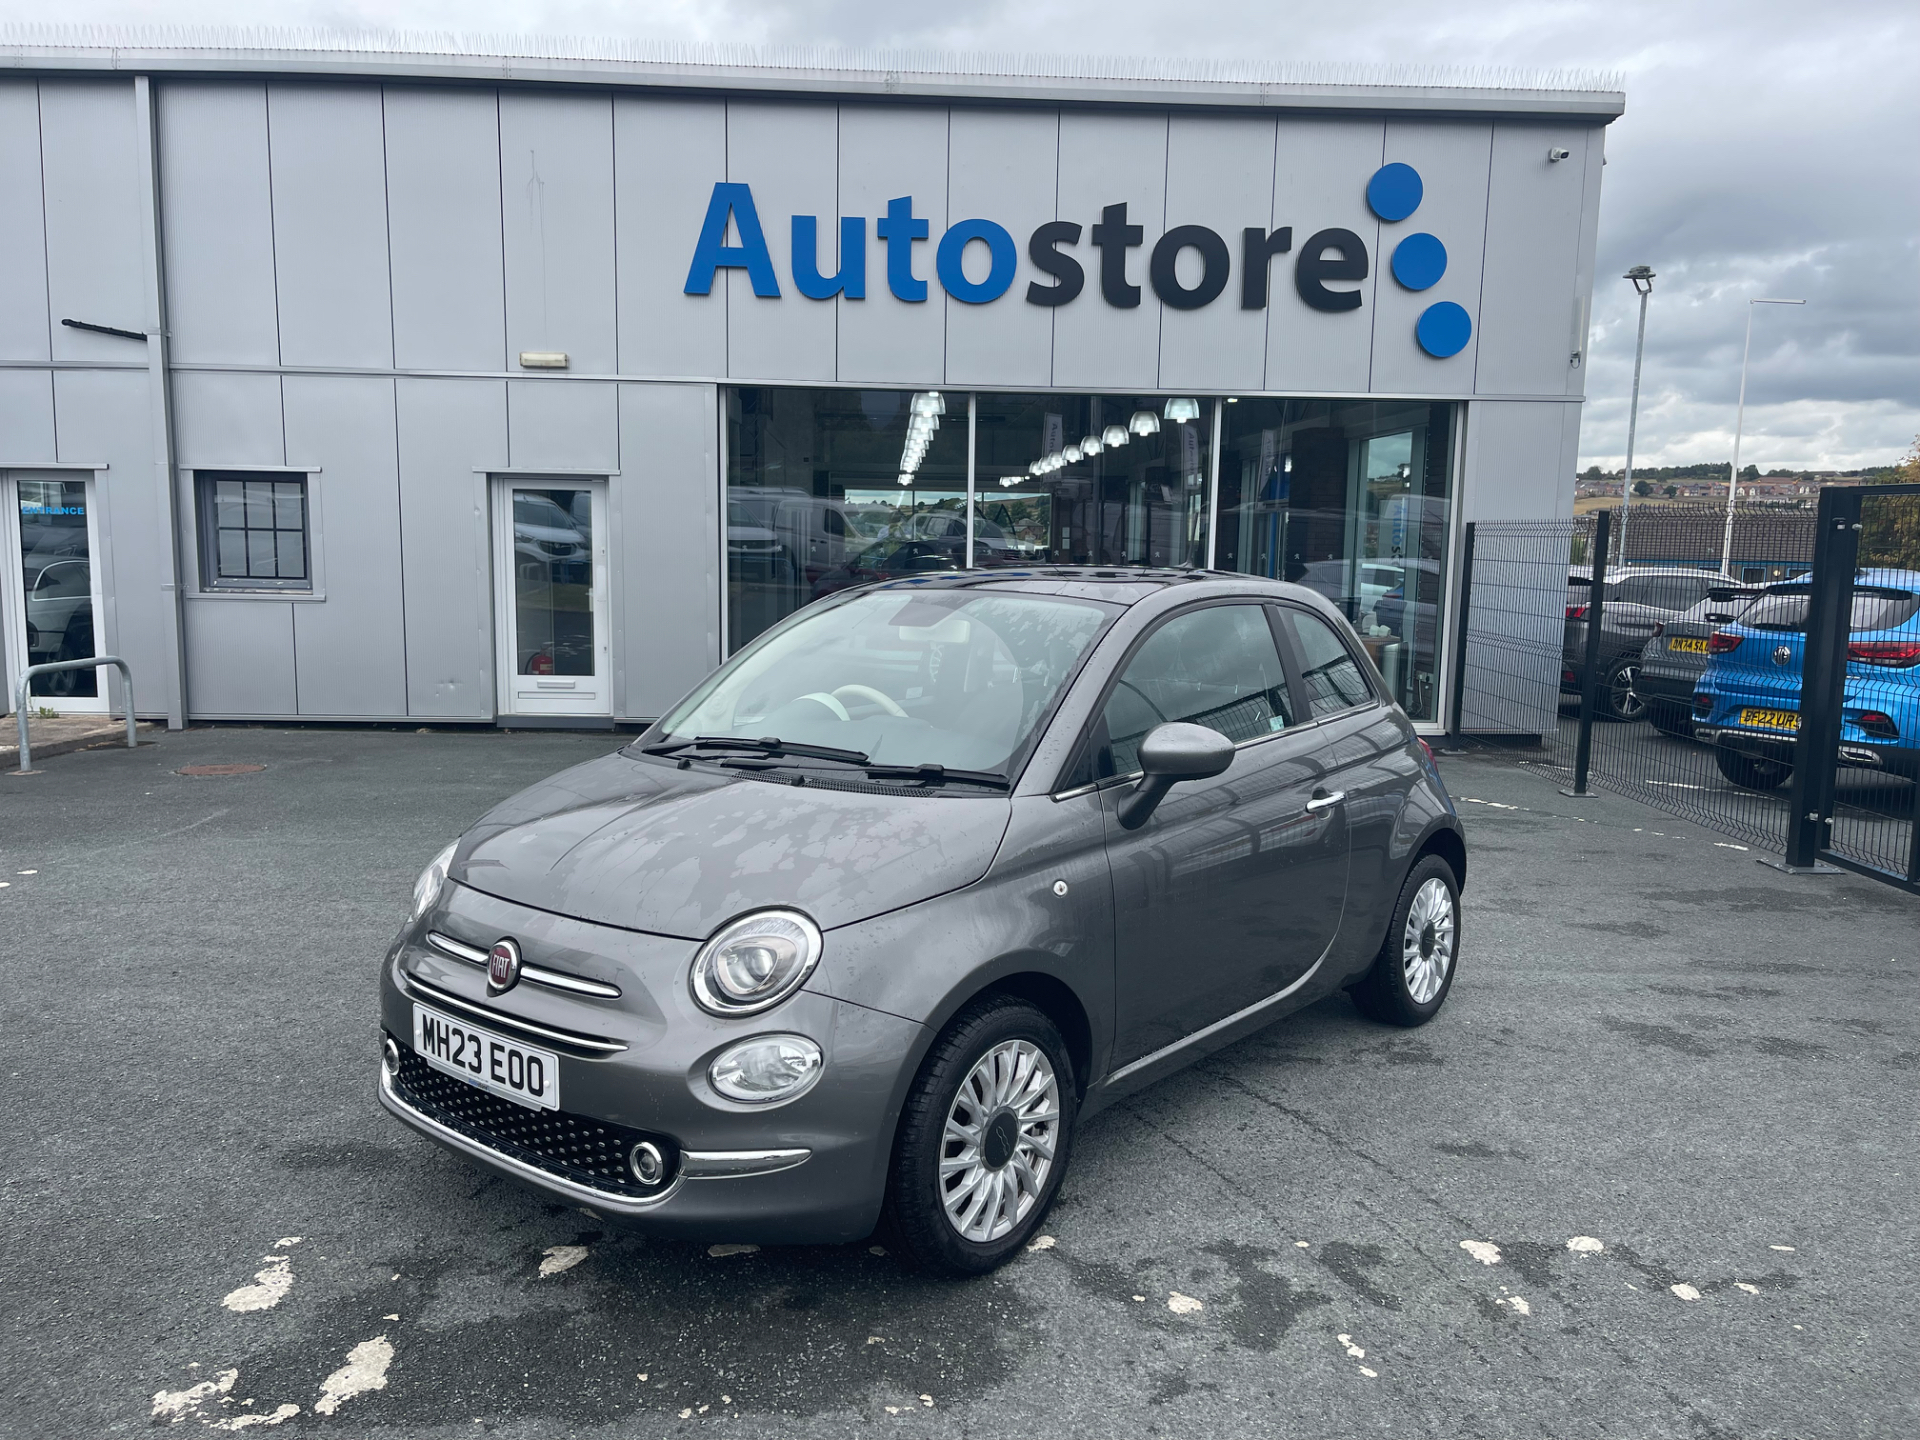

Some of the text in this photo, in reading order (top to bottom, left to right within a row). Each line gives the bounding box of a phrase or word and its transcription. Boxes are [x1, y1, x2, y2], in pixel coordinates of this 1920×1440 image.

[683, 182, 1369, 312] Autostore
[22, 506, 84, 515] ENTRANCE
[492, 954, 510, 979] FIAT
[422, 1013, 482, 1075] MH23
